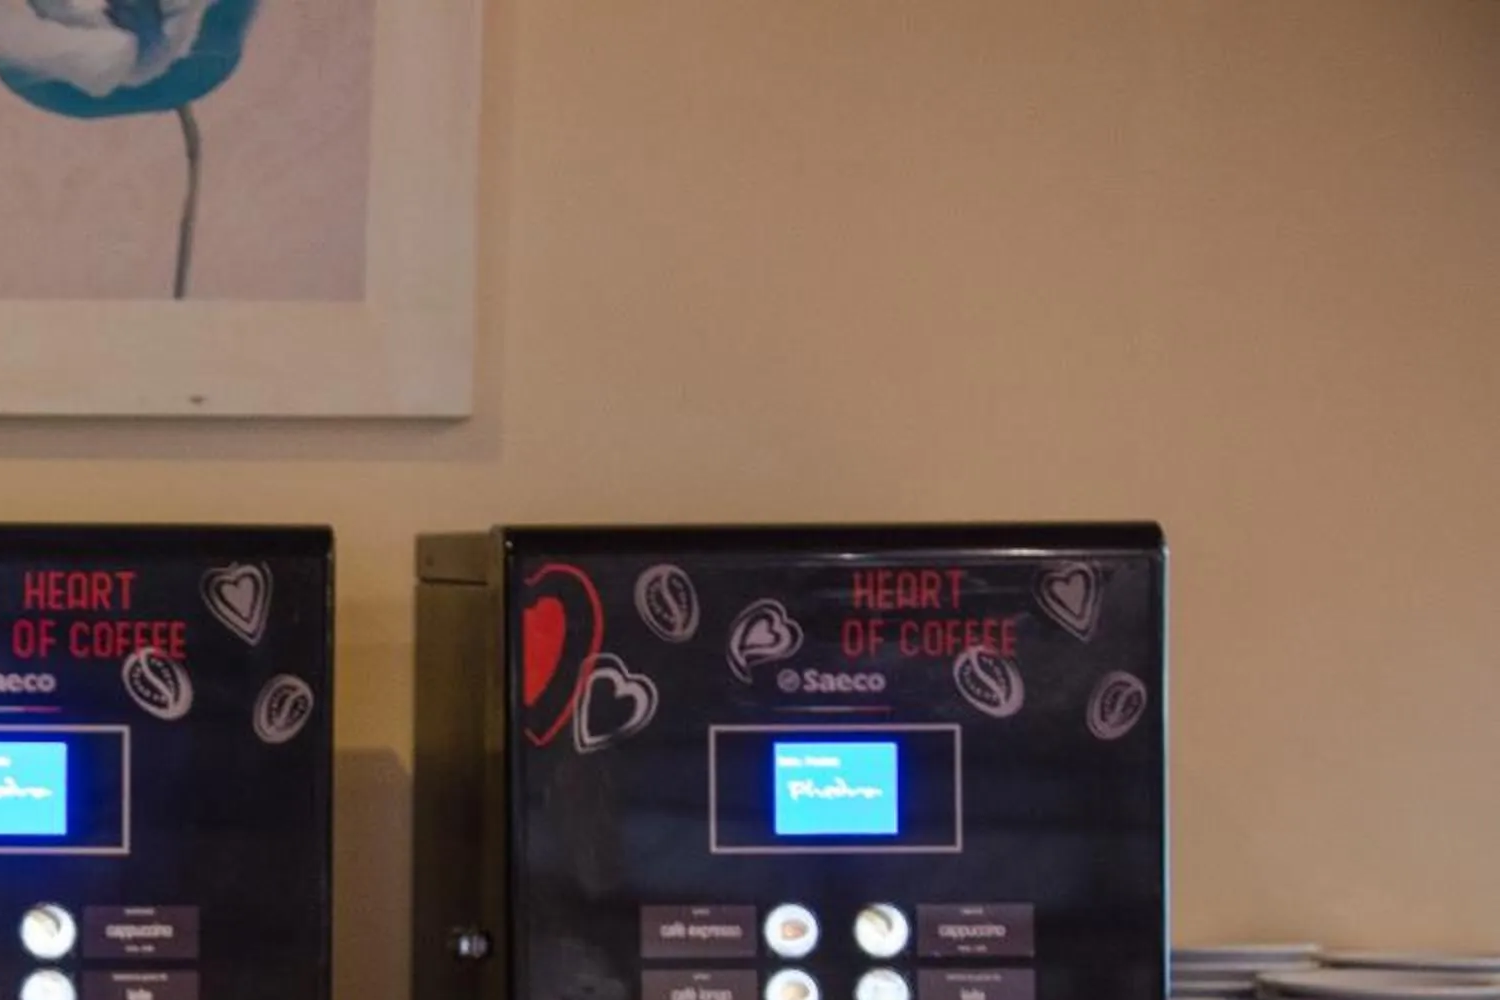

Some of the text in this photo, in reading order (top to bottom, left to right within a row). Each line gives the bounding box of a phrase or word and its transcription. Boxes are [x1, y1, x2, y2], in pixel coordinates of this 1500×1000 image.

[22, 569, 135, 610] HEART
[852, 568, 966, 609] HEART
[11, 618, 187, 659] OF COFFEE
[841, 618, 1017, 658] OF COFFEE
[803, 667, 886, 693] Saeco
[937, 923, 1007, 941] cappuccino
